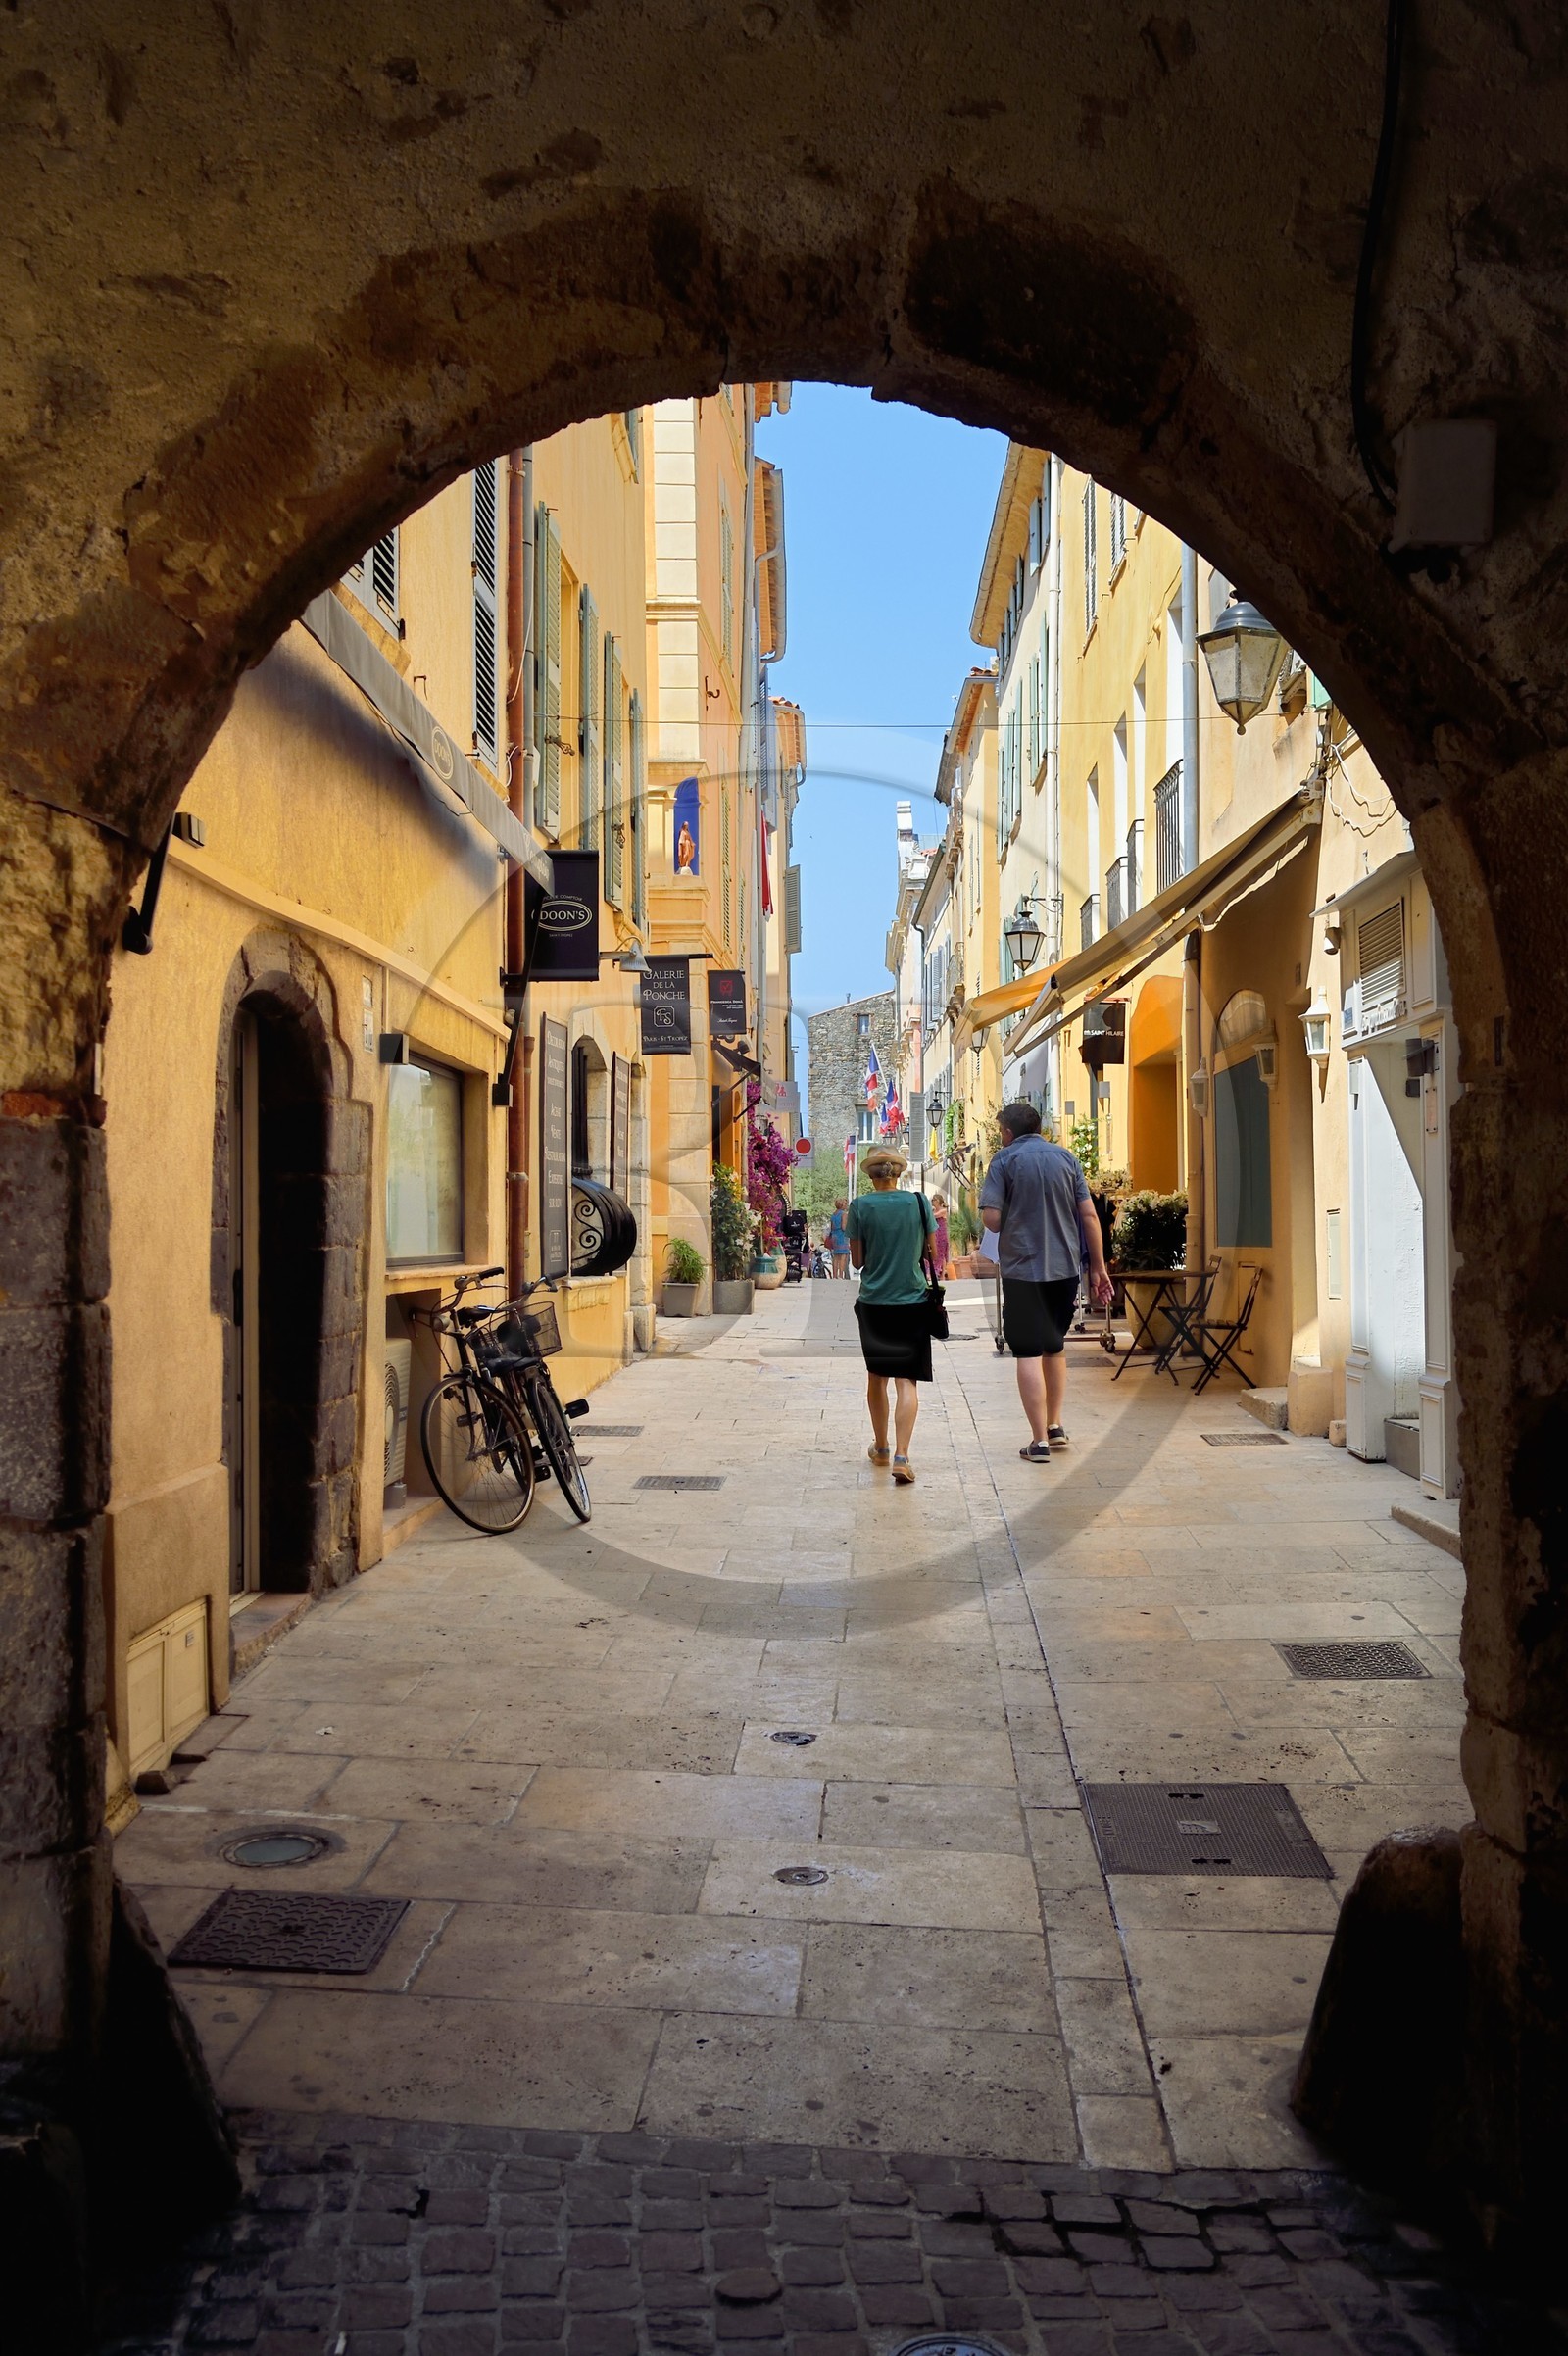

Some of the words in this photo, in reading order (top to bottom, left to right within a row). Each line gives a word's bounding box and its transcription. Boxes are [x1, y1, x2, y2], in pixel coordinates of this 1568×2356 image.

[539, 910, 585, 920] DOON'S
[643, 969, 685, 979] GALERIE
[643, 989, 686, 1001] PONCHE
